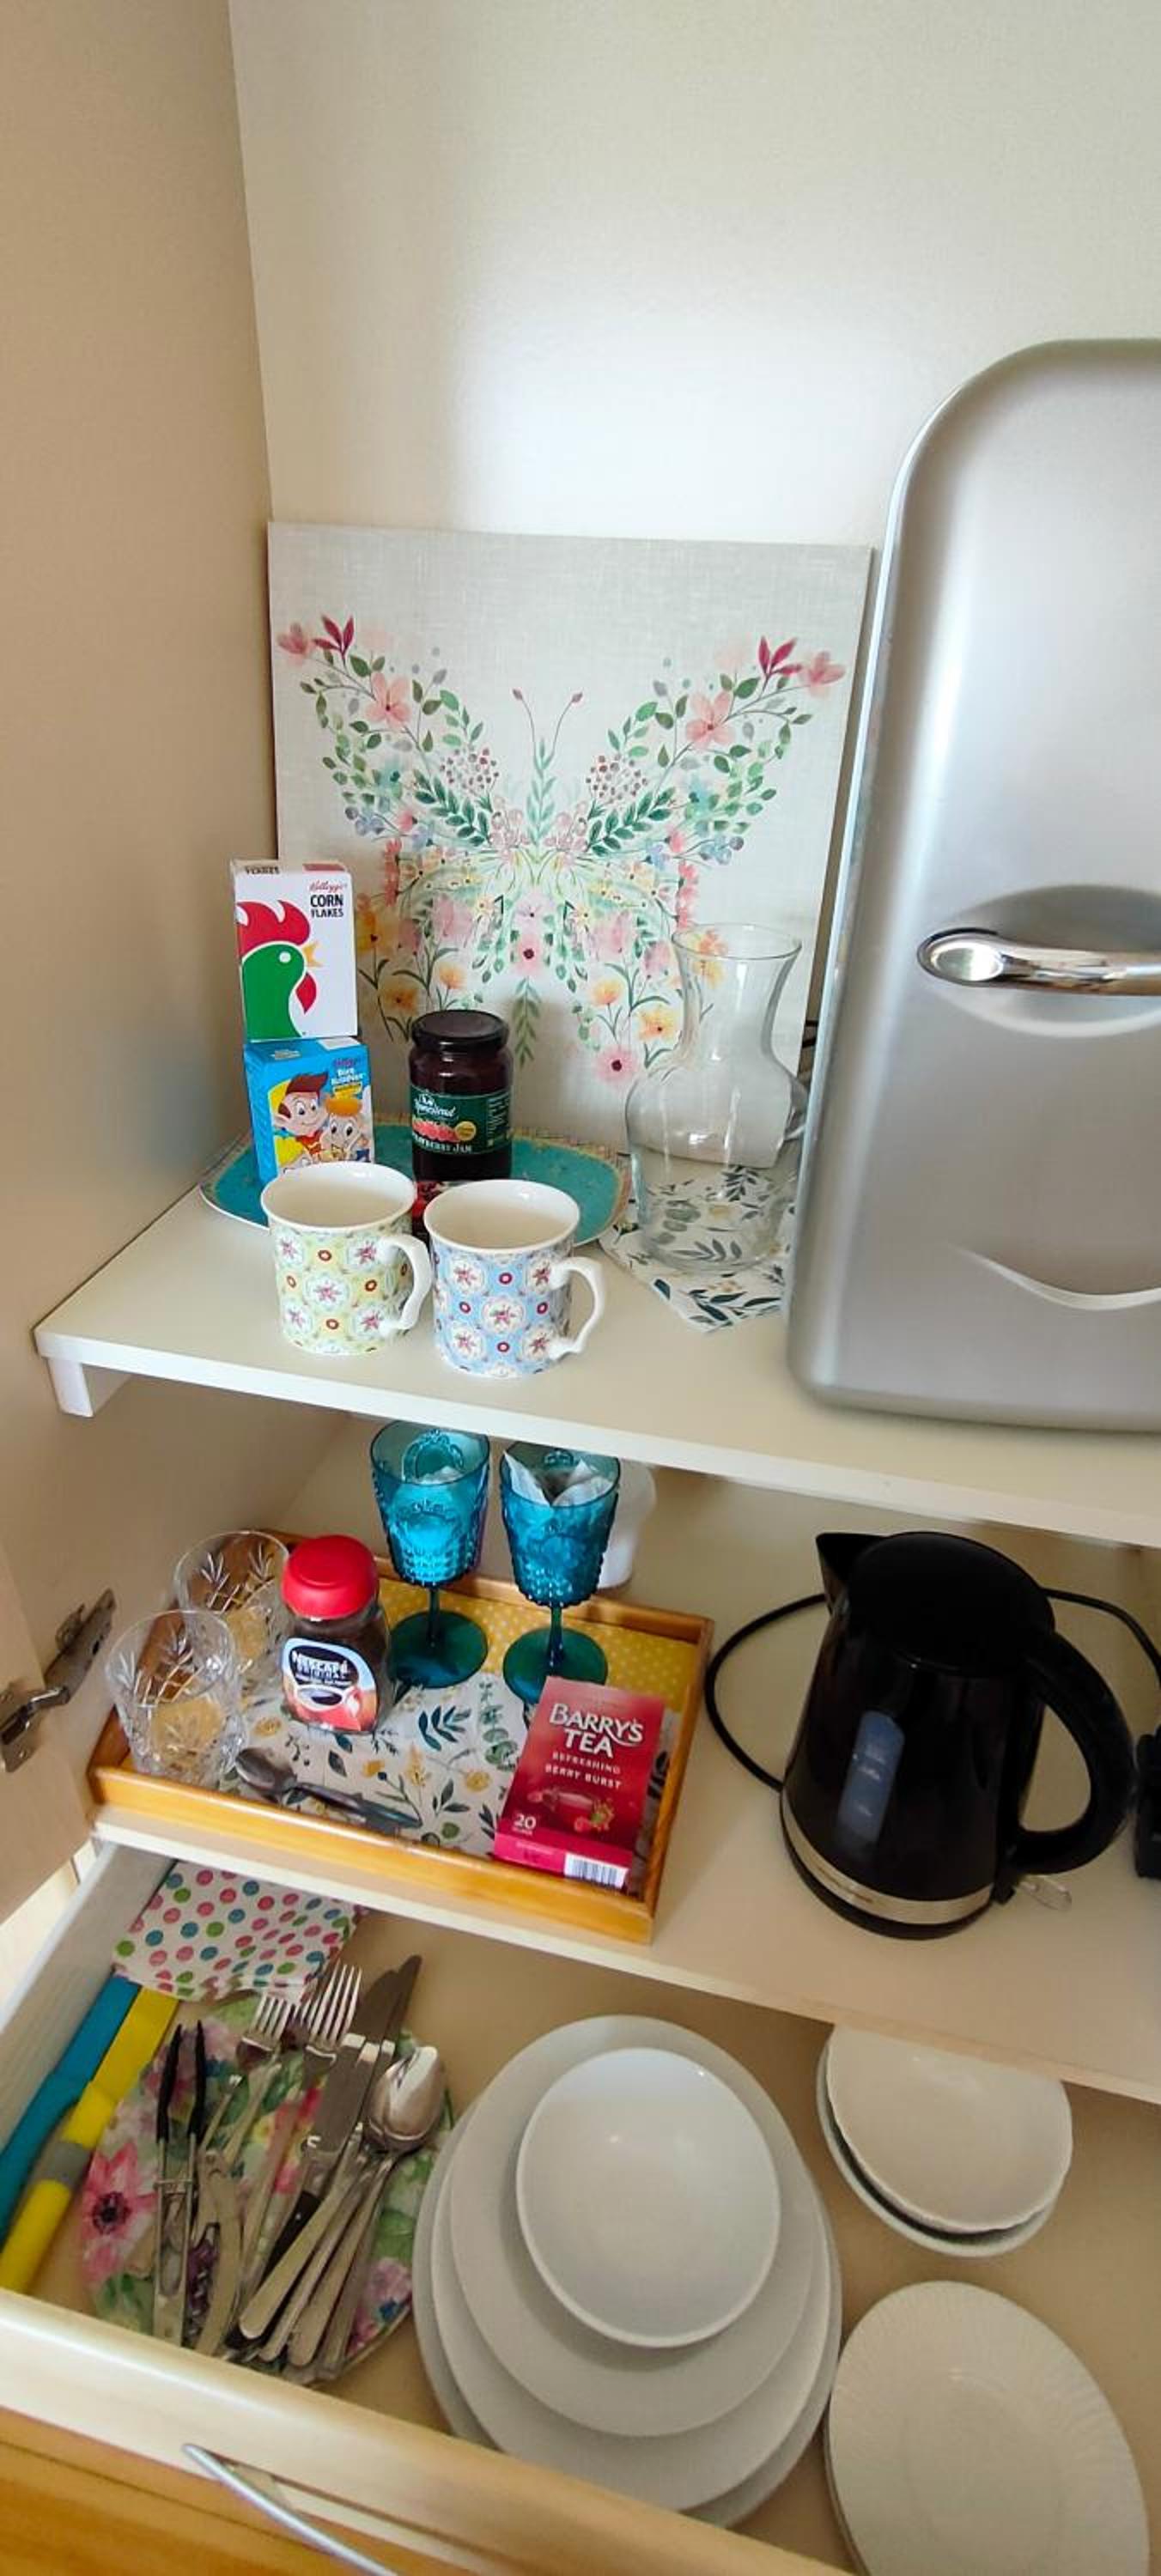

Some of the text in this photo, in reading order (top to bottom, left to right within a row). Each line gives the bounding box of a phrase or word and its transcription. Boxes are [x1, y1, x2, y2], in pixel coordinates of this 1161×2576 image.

[310, 894, 343, 907] CORN
[311, 908, 343, 918] FLAKES
[550, 1703, 643, 1747] BARRY'S
[563, 1728, 614, 1759] TEA
[552, 1752, 621, 1775] REFRESHING
[544, 1764, 622, 1789] BERRY BURST
[514, 1813, 537, 1830] 20
